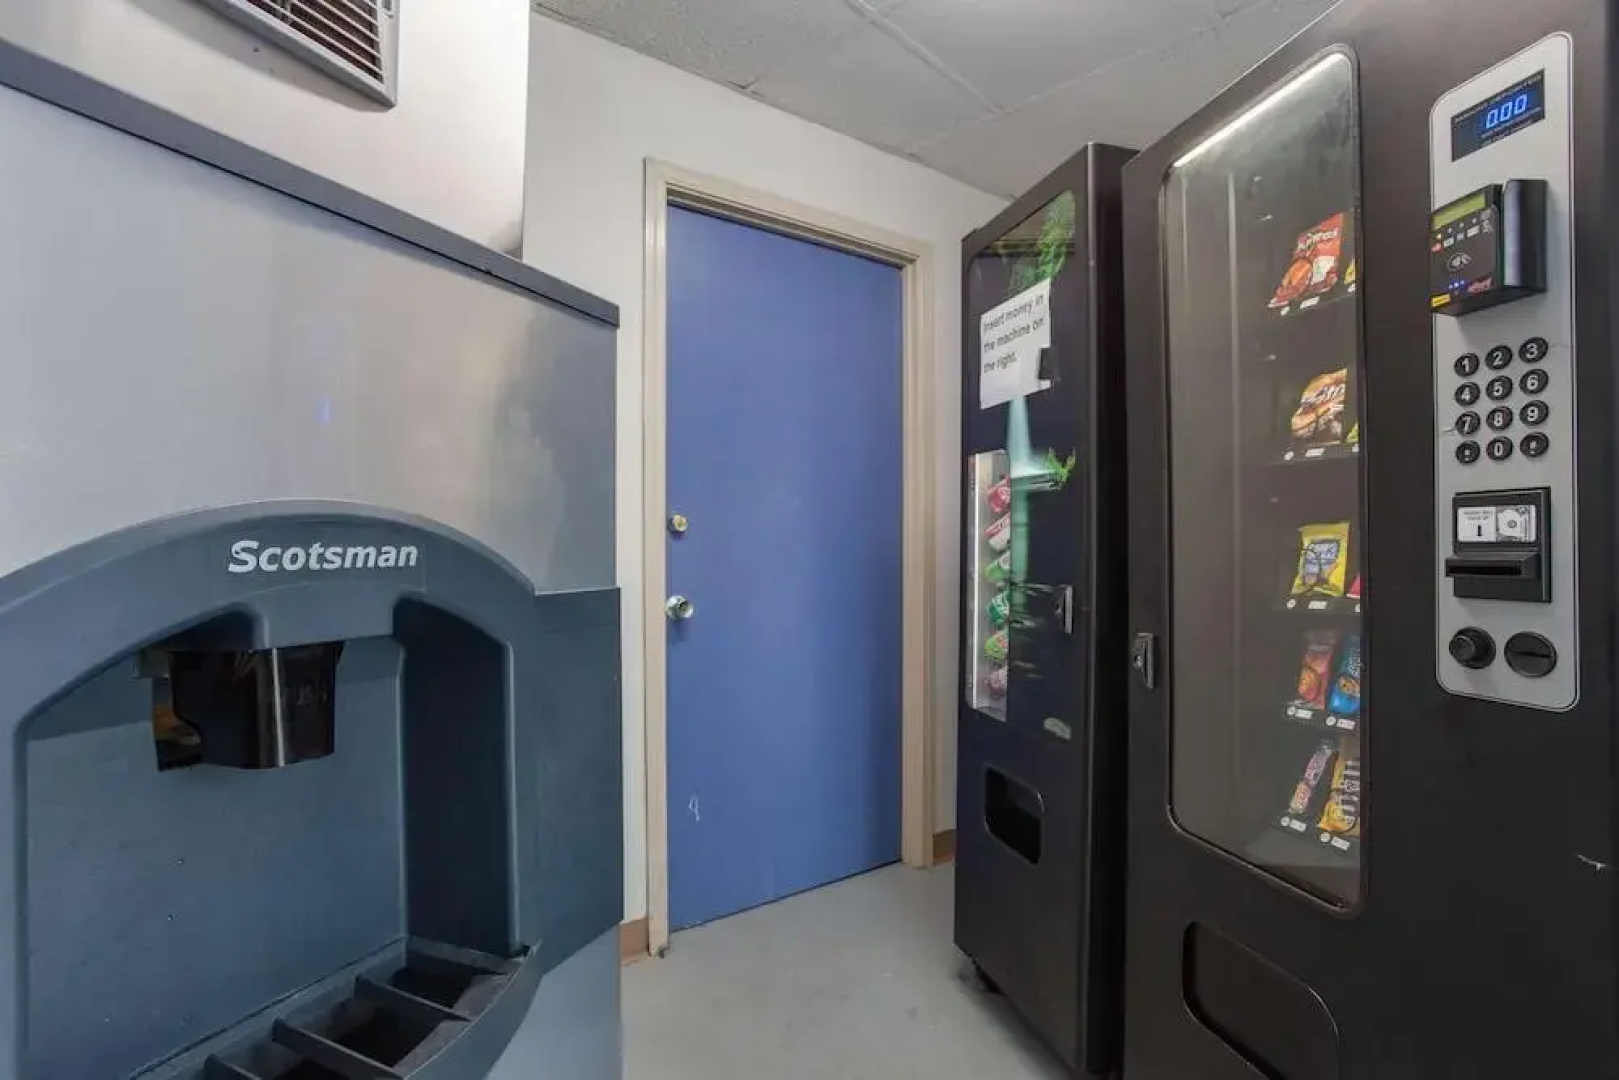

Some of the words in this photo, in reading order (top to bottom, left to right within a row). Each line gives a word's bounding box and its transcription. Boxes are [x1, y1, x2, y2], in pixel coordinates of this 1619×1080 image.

[997, 324, 1031, 347] machine
[1461, 357, 1470, 372] 1
[1492, 351, 1503, 366] 2
[1526, 343, 1538, 359] 3
[1461, 387, 1470, 401] 4
[1492, 381, 1503, 396] 5
[1526, 375, 1538, 390] 6
[1461, 417, 1471, 432] 7
[1493, 412, 1503, 427] 8
[1527, 406, 1538, 422] 9
[1493, 441, 1503, 456] 0
[228, 540, 419, 573] Scotsman
